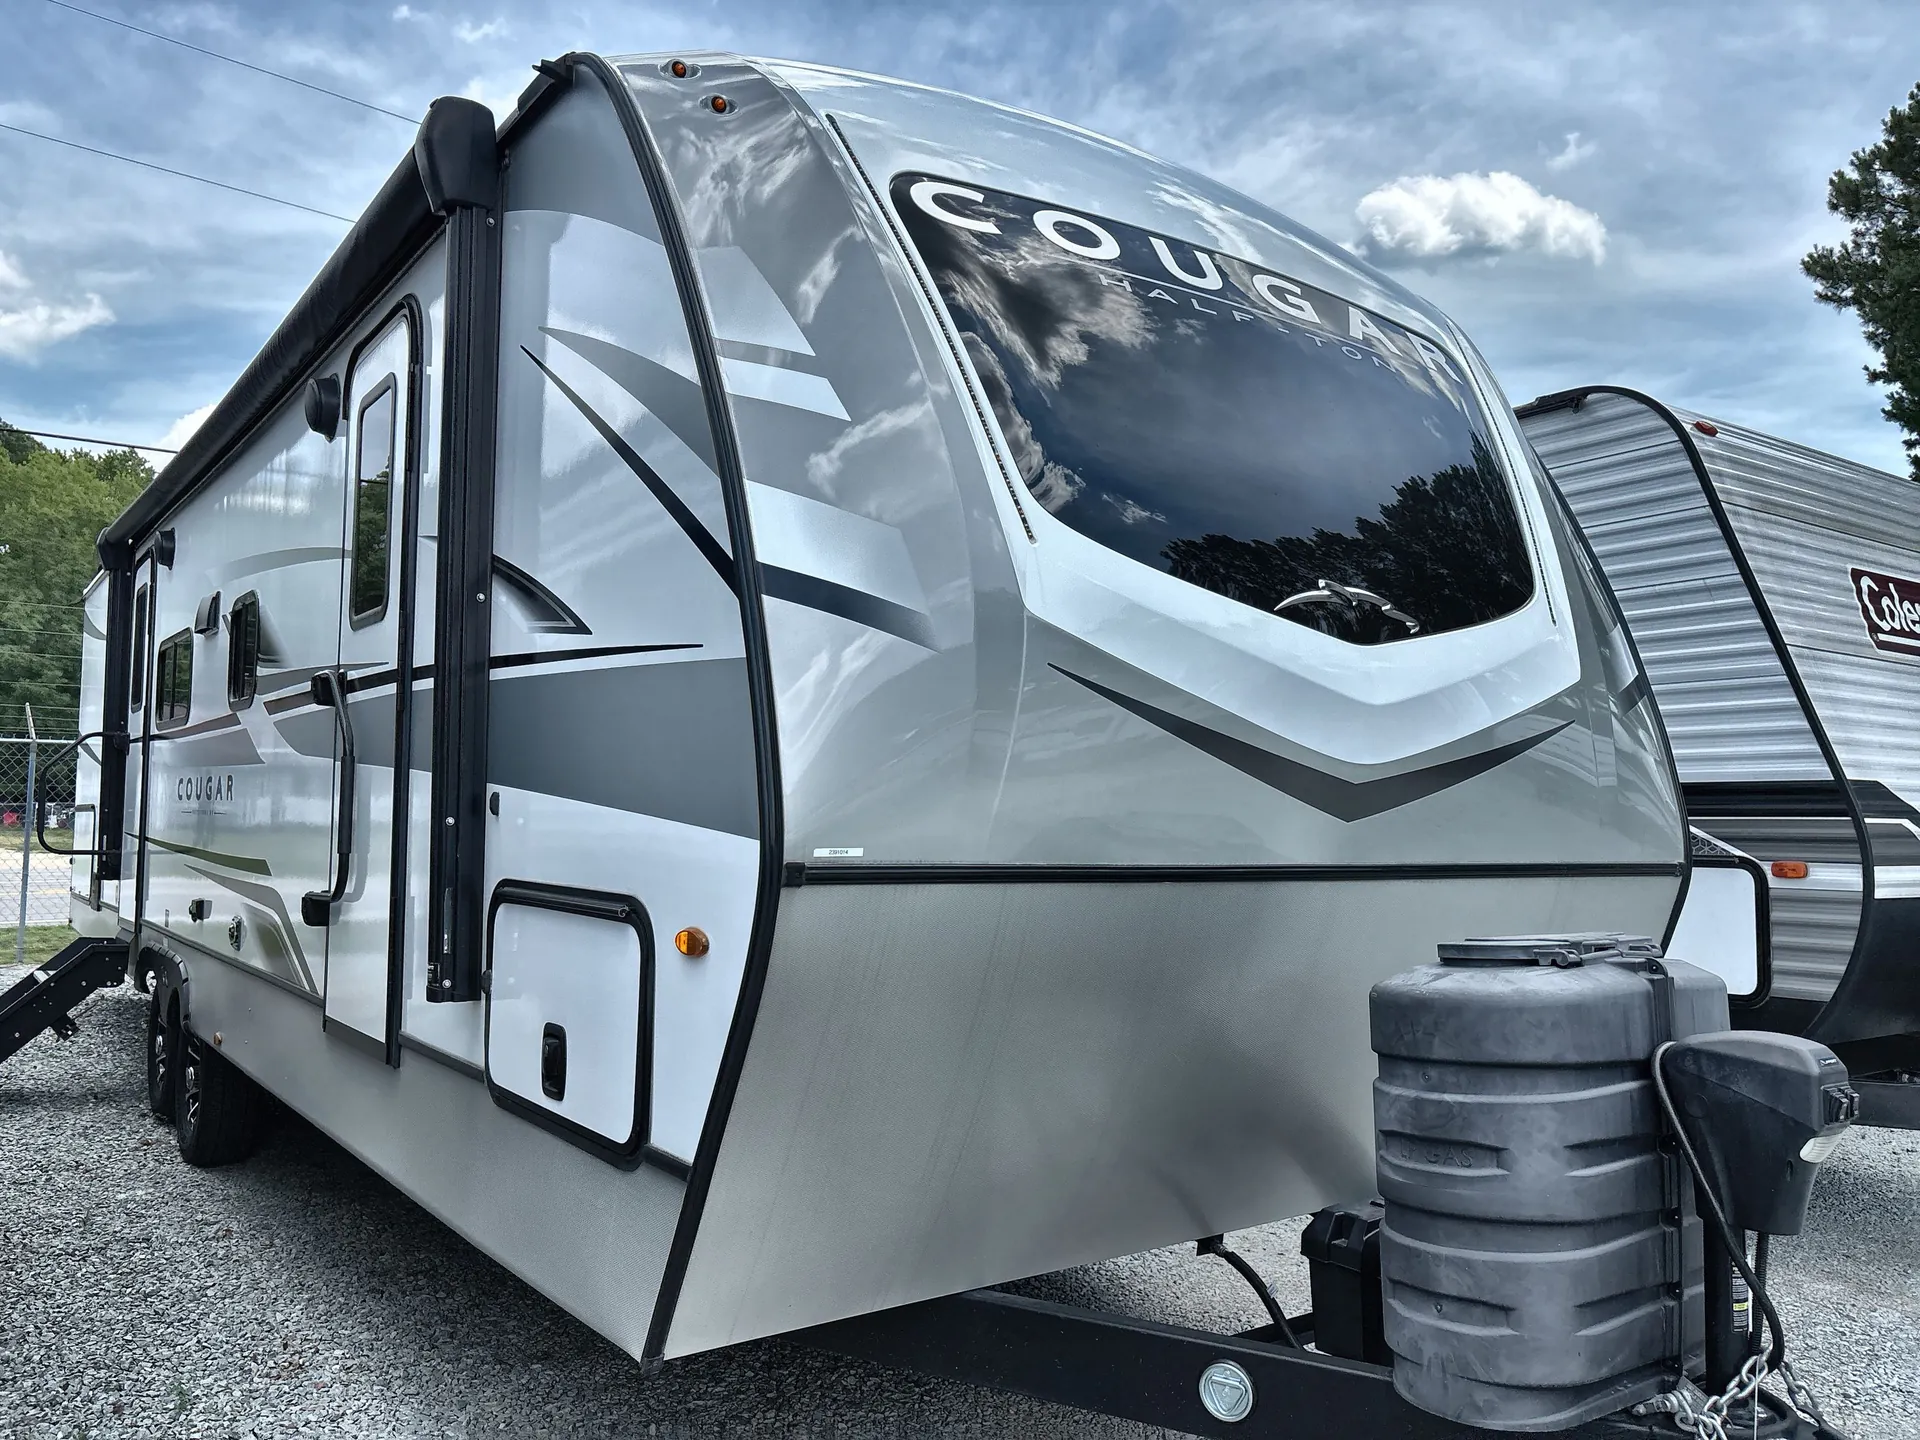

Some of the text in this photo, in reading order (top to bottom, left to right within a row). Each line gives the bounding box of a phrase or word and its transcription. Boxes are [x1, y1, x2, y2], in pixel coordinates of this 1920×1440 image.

[909, 180, 1464, 386] COUGAR
[177, 774, 234, 801] COUGAR
[1424, 1145, 1473, 1168] GAS
